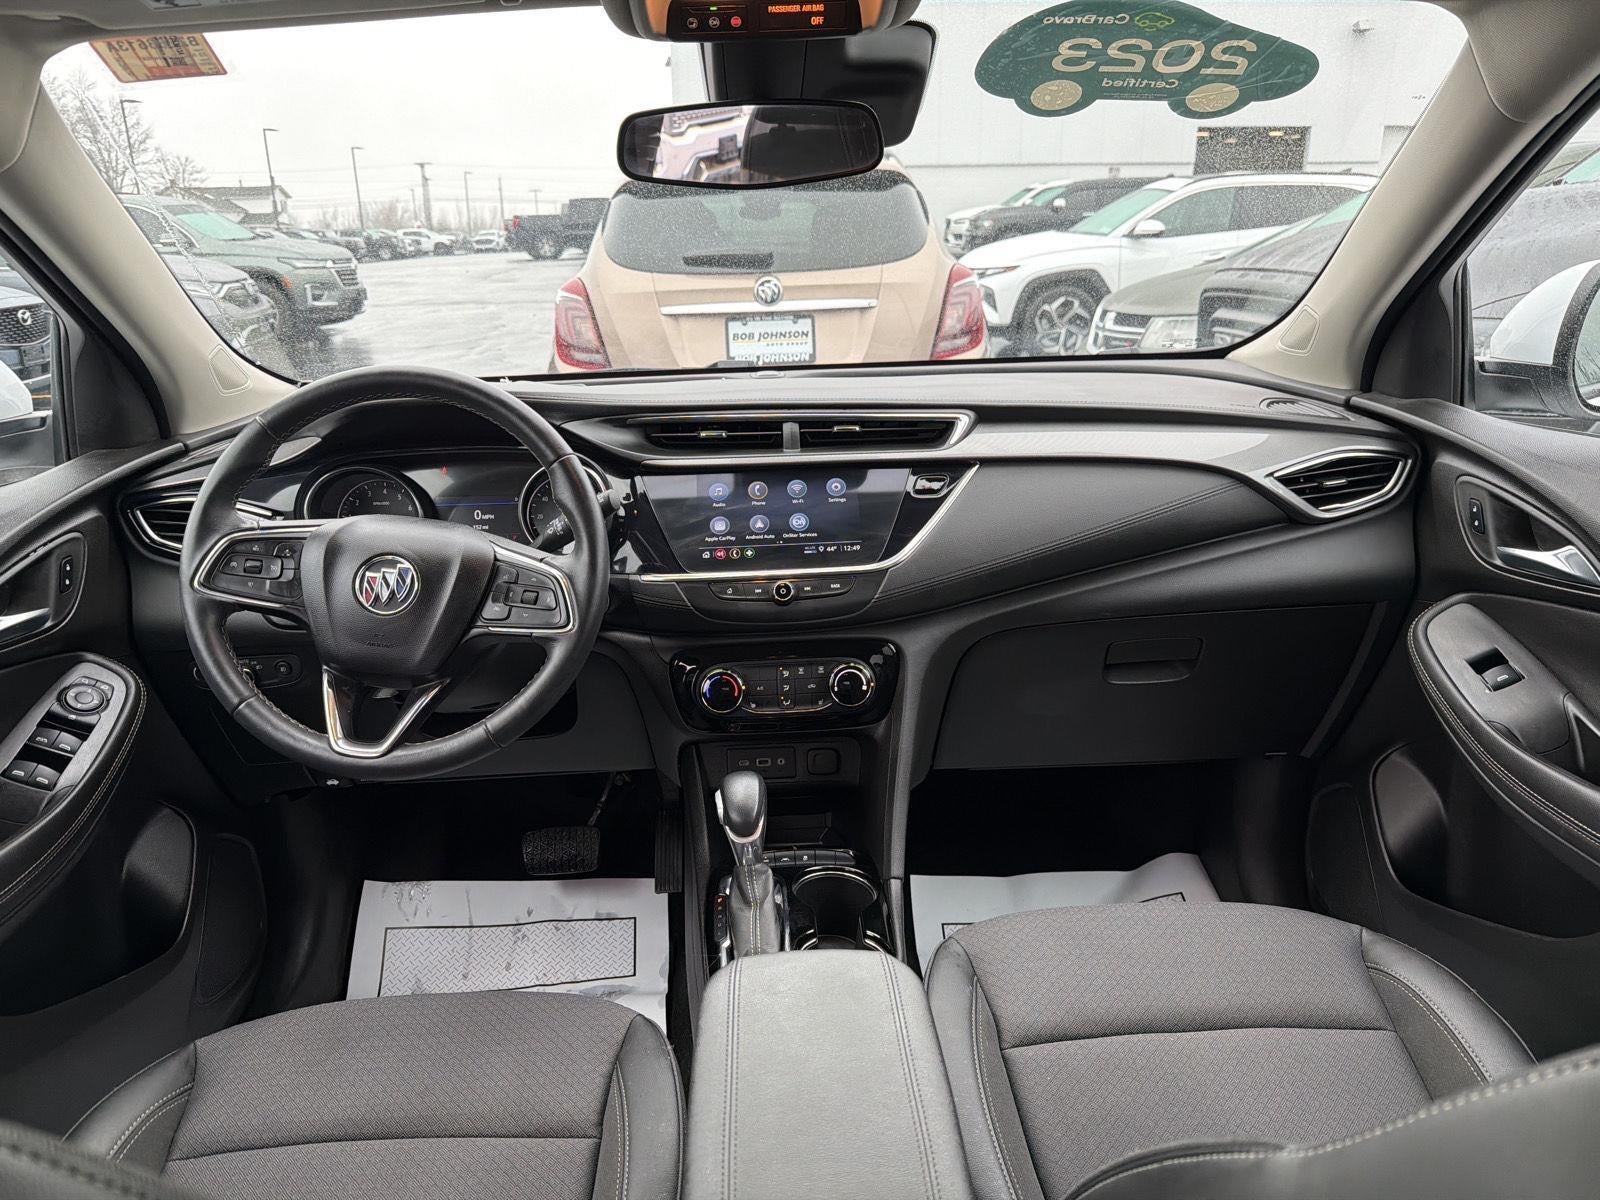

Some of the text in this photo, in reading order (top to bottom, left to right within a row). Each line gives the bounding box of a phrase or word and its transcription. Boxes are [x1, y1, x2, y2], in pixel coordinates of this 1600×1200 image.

[767, 5, 801, 13] PASSENGER
[810, 16, 825, 26] OFF
[732, 330, 809, 342] BOB JOHNSON
[757, 352, 810, 366] JOHNSON
[473, 509, 482, 520] 0
